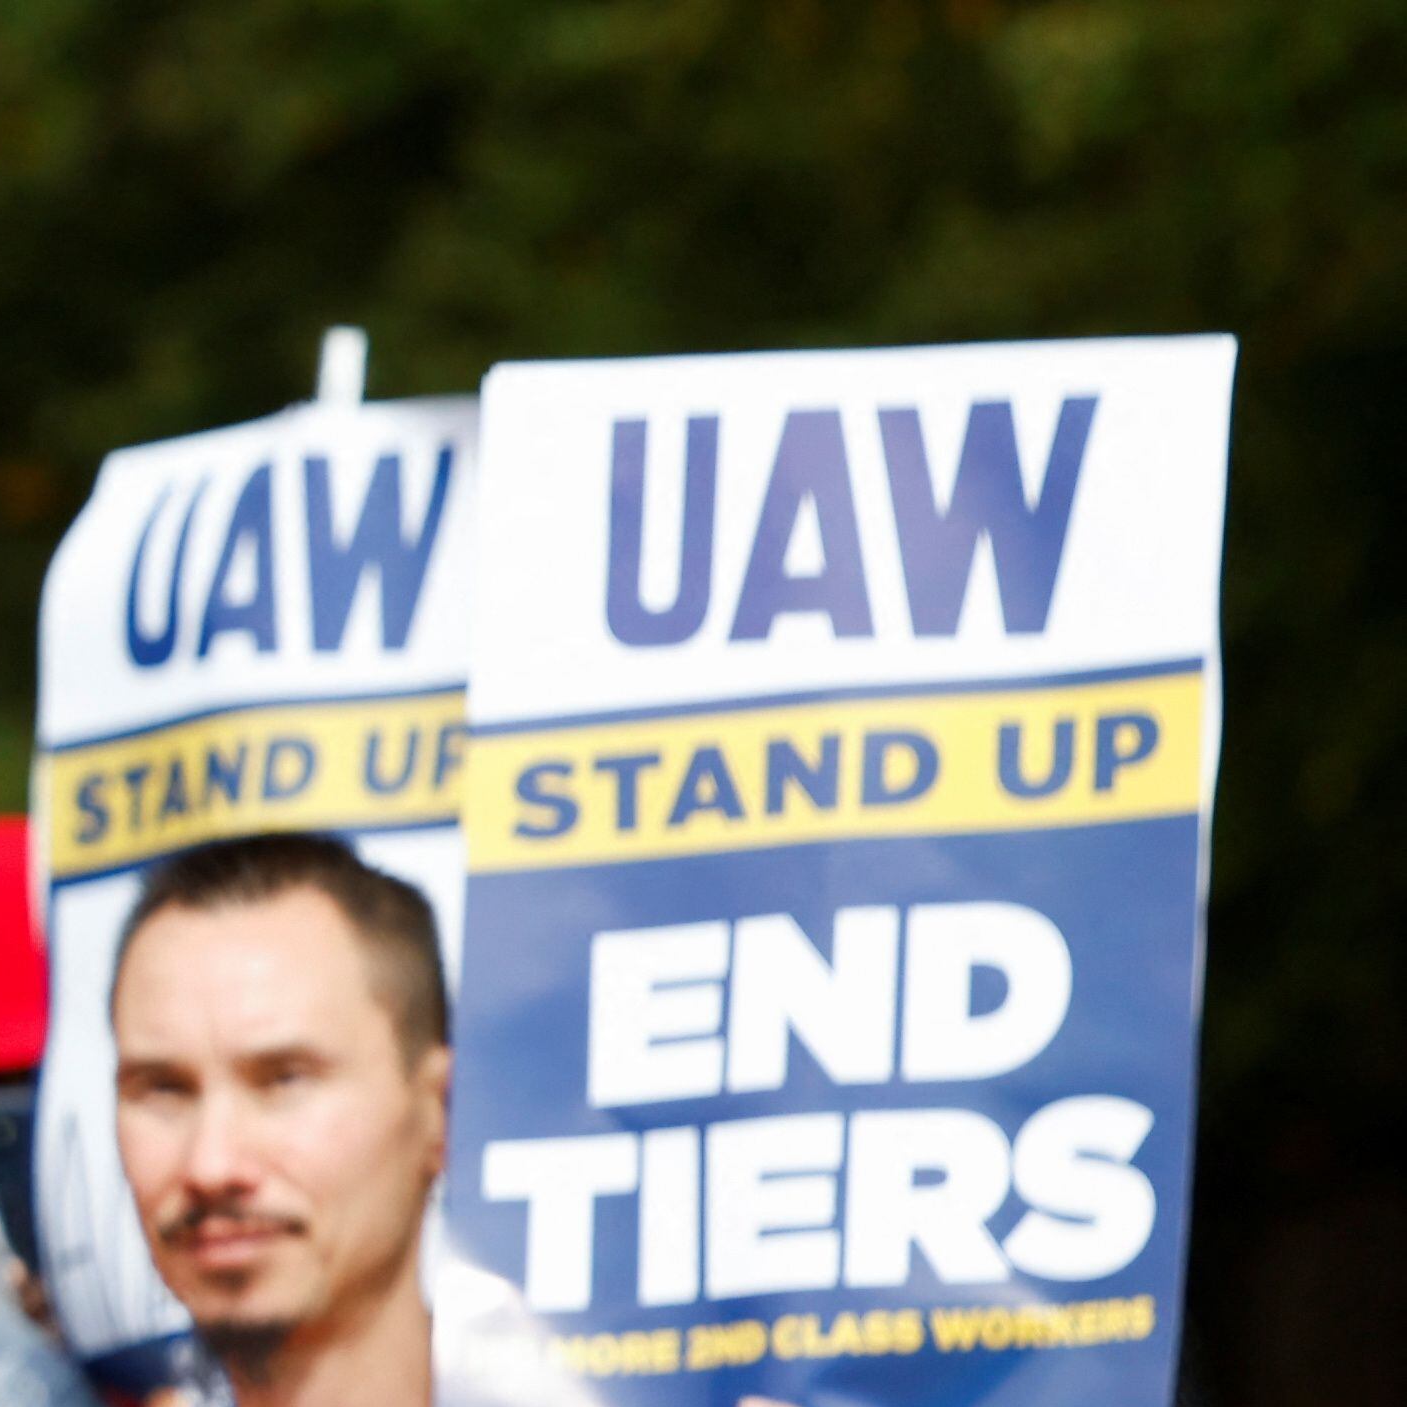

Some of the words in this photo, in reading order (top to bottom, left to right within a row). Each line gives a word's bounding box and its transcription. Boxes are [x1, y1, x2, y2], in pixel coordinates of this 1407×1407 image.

[126, 447, 453, 668] UAW
[605, 394, 1100, 649] UAW
[73, 736, 317, 846] STAND
[512, 728, 941, 840] STAND
[995, 712, 1161, 800] UP
[589, 899, 1074, 1108] END
[482, 1093, 1158, 1312] TIERS
[686, 1318, 769, 1370] 2ND
[771, 1308, 925, 1361] CLASS
[930, 1294, 1157, 1353] WORKERS
